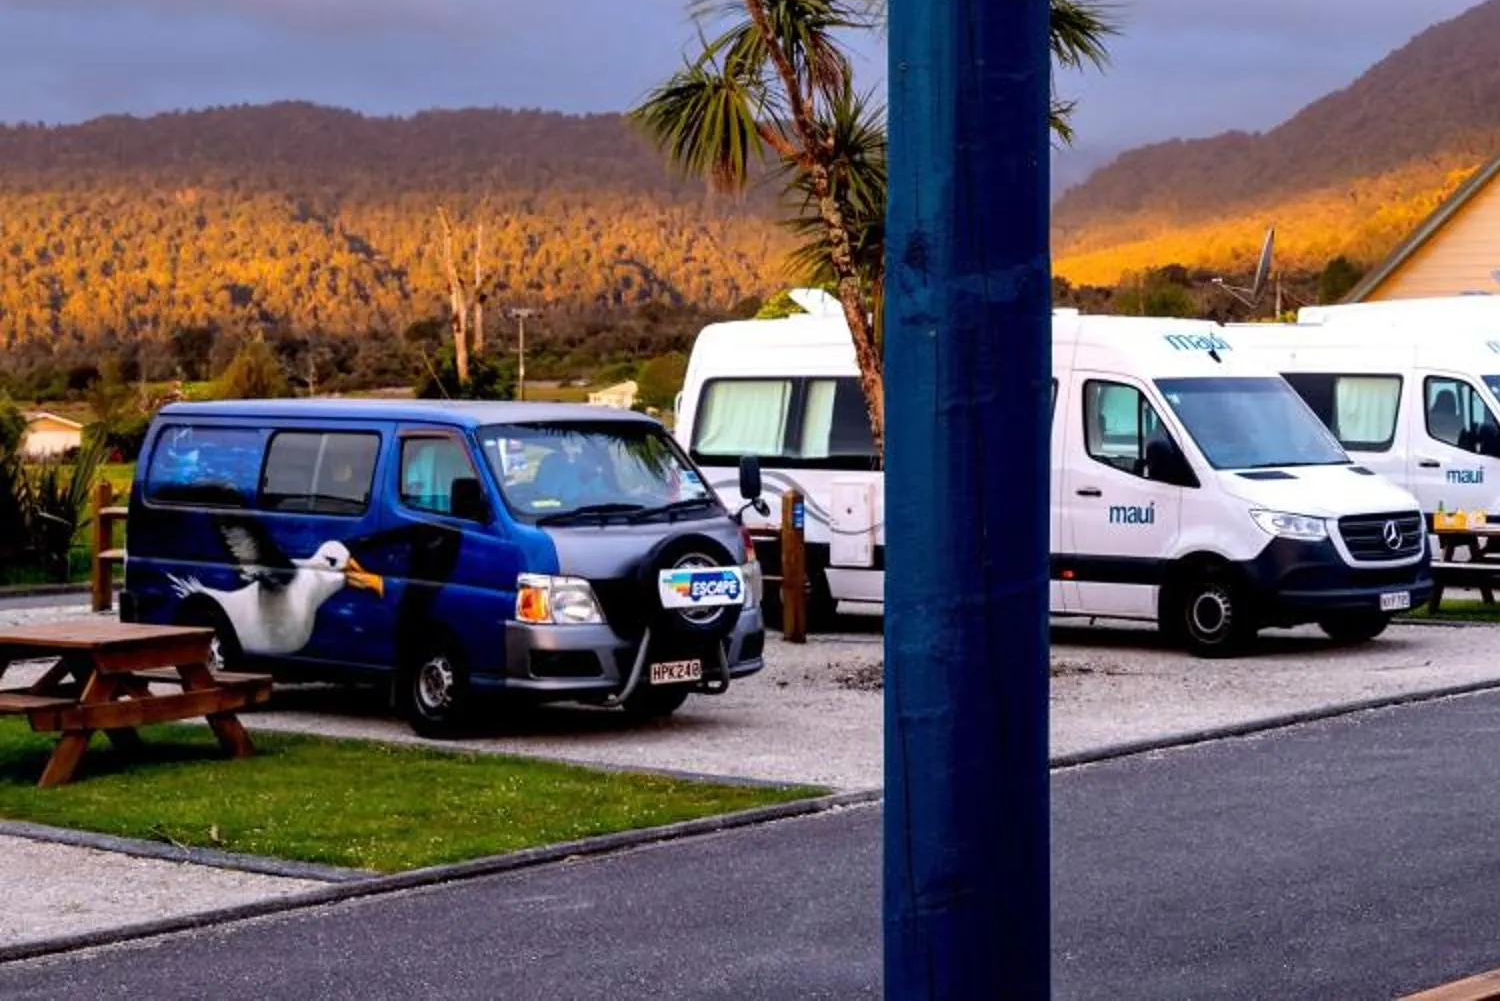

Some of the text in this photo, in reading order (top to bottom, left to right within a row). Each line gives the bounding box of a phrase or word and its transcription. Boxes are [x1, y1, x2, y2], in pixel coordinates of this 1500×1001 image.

[1446, 465, 1484, 484] maui
[1109, 501, 1155, 524] maui
[692, 580, 737, 596] ESCAPE
